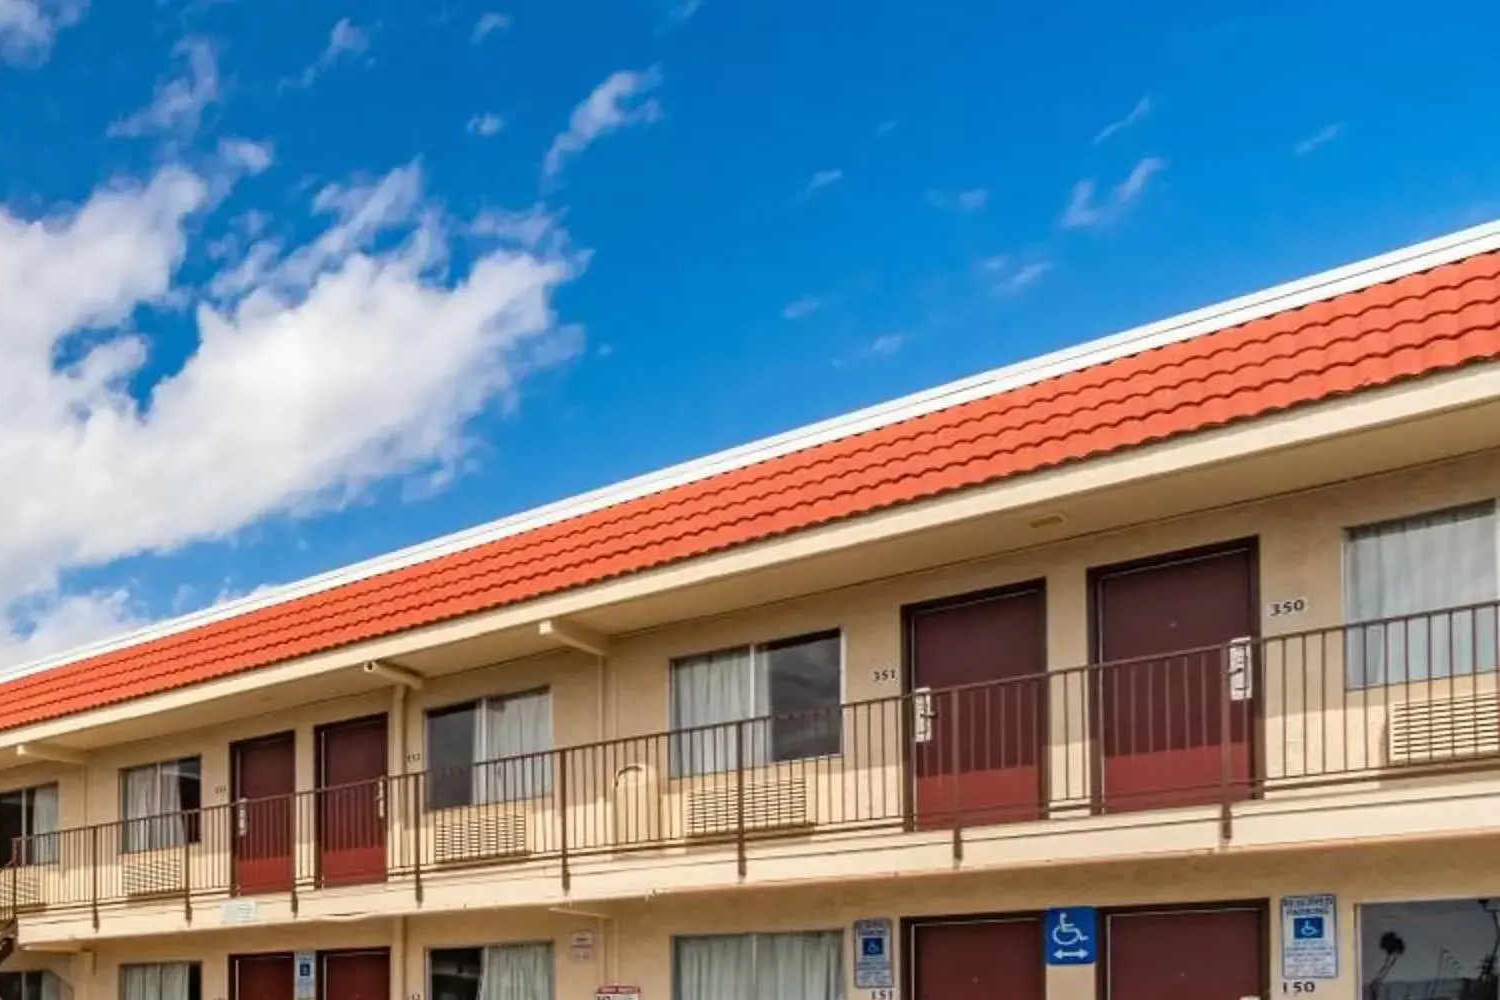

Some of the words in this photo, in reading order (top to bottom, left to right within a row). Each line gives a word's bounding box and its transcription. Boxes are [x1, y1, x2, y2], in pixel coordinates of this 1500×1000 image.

[1270, 599, 1305, 616] 350
[872, 669, 895, 682] 351
[1283, 981, 1316, 993] 150
[871, 990, 893, 1000] 151
